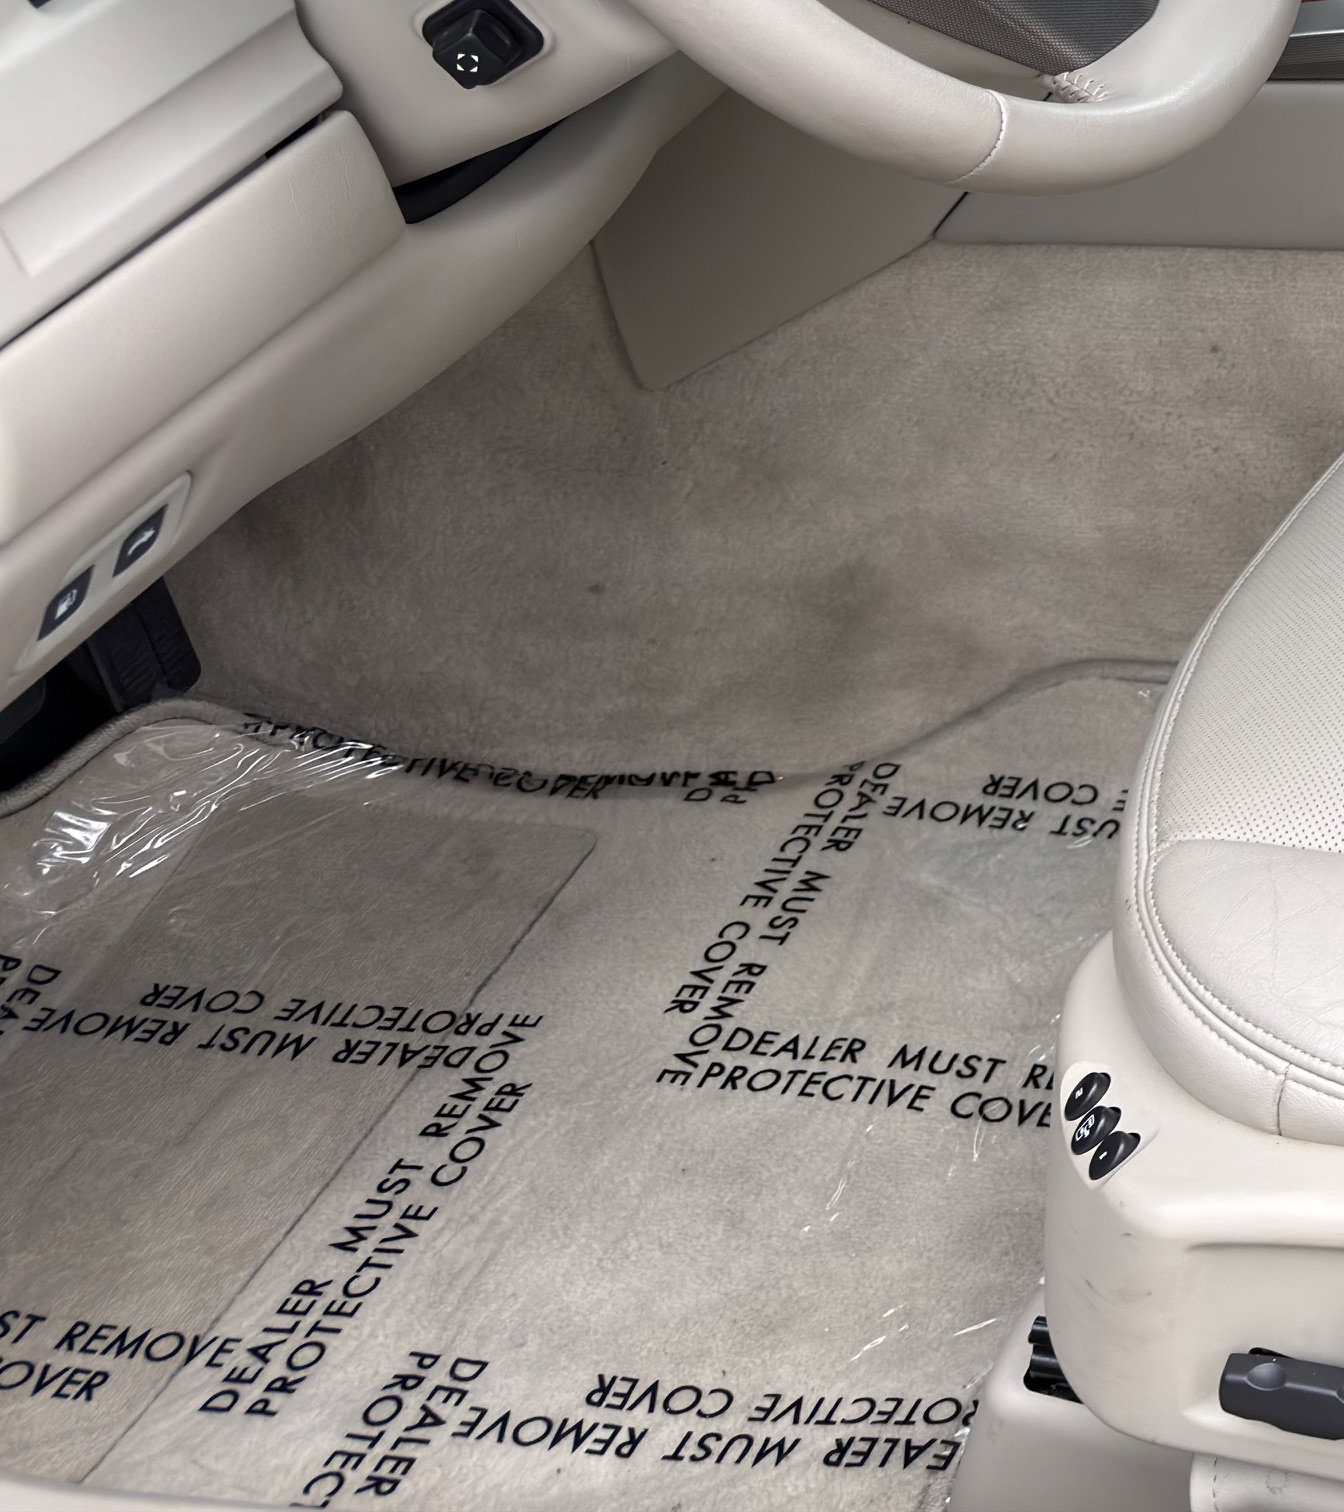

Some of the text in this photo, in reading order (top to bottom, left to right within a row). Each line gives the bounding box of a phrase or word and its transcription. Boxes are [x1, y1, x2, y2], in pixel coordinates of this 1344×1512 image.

[882, 795, 1121, 839] UST REMOVE
[981, 774, 1099, 806] COVER
[740, 760, 867, 909] PROTECTIVE
[656, 762, 901, 1087] DEALER MUST REMOVE
[663, 920, 750, 1014] COVER
[22, 1007, 477, 1069] DEALER MUST REMOVE
[139, 982, 505, 1037] PROTECTIVE COVER
[722, 1026, 867, 1064] DEALER
[887, 1043, 1006, 1085] MUST
[696, 1061, 1053, 1129] PROTECTIVE COVE
[198, 1014, 544, 1413] DEALER MUST REMOVE
[244, 1081, 534, 1418] PROTECTIVE COVER
[0, 1310, 243, 1369] ST REMOVE
[0, 1360, 110, 1403] OVER
[584, 1373, 980, 1427] OTECTIVE COVER
[353, 1357, 490, 1497] DEALER
[450, 1406, 963, 1472] EALER MUST REMOVE
